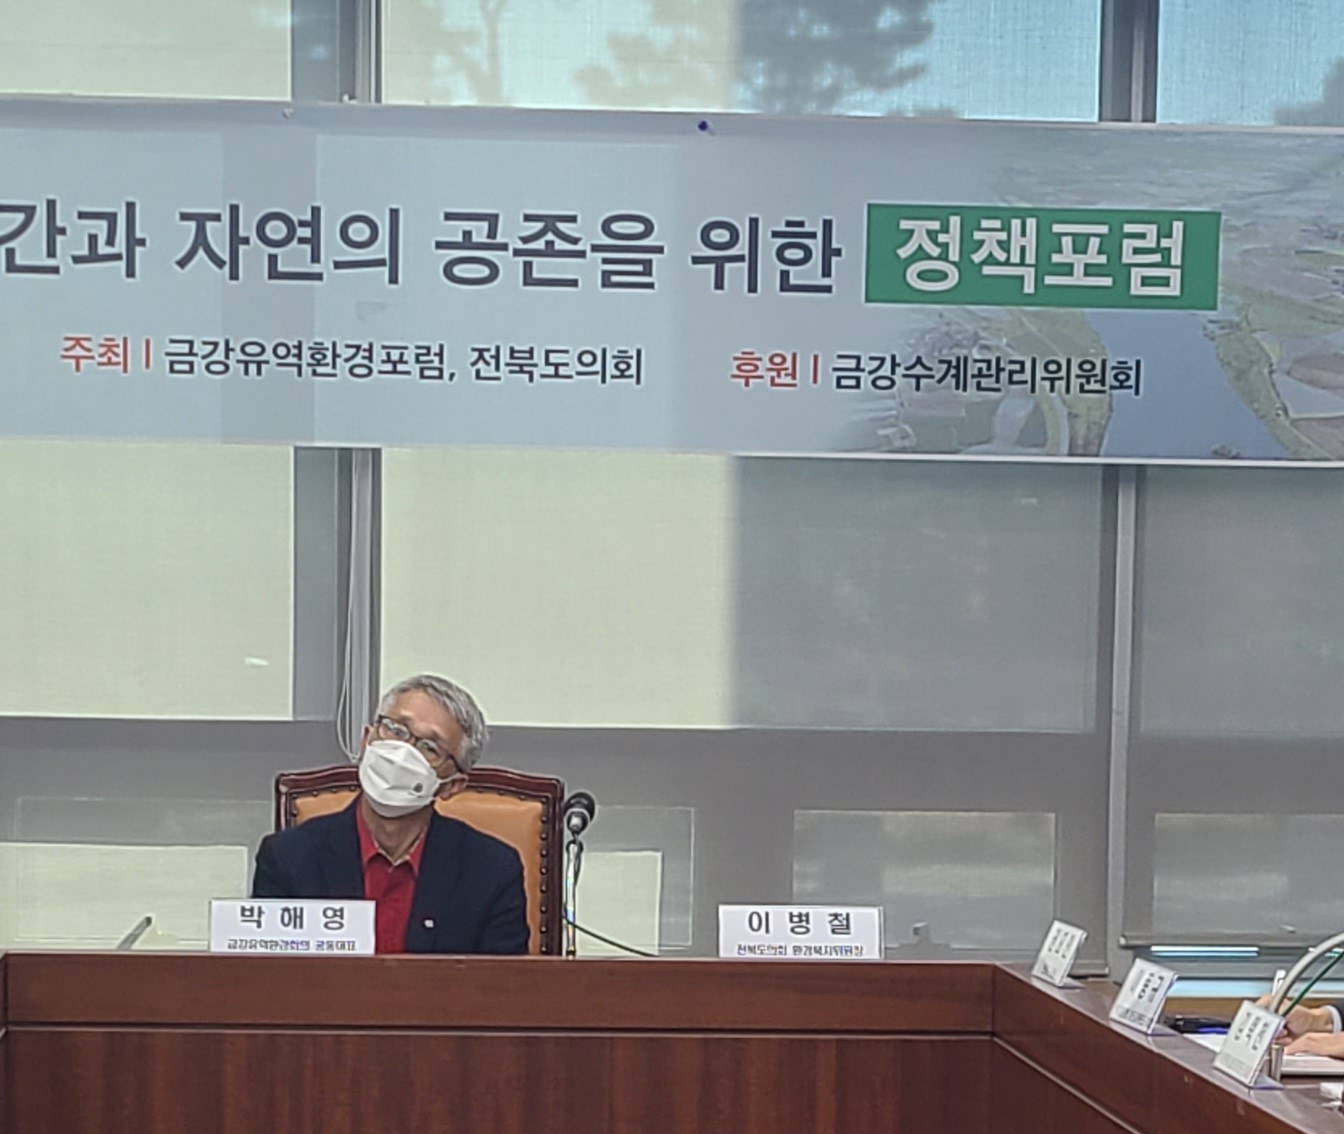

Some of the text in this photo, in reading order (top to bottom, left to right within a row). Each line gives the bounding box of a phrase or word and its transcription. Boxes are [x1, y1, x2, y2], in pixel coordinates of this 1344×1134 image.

[174, 203, 402, 286] 자연의
[433, 207, 666, 292] 공존을
[690, 215, 843, 295] 위한
[896, 214, 1185, 299] 정책포럼
[59, 335, 643, 385] 주최 금강유역환경포럼, 전북도의회
[730, 351, 1142, 396] 후원 금강수계관리위원회
